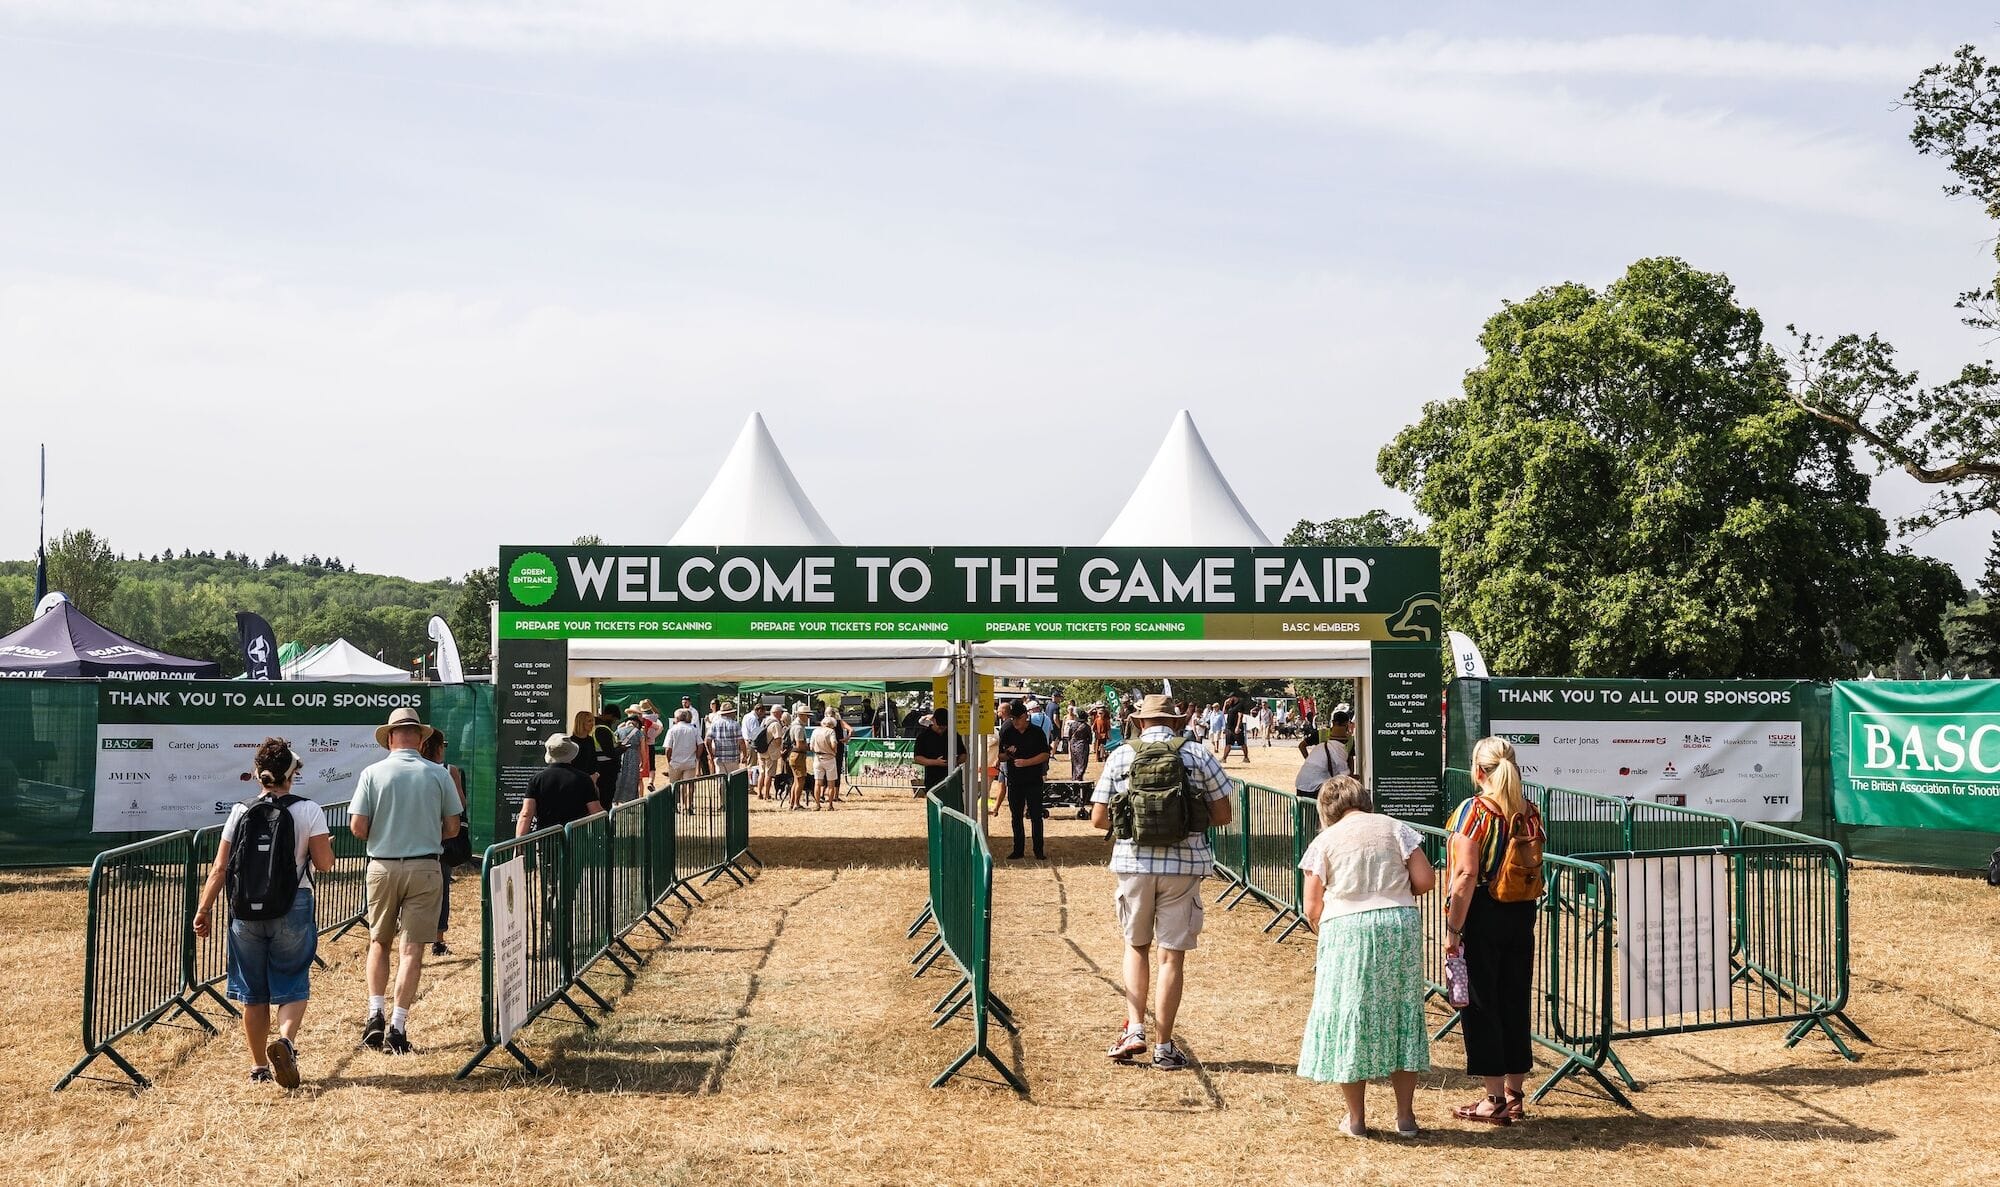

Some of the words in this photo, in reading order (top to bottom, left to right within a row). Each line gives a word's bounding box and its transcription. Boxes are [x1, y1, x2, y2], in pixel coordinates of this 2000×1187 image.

[567, 557, 835, 602] WELCOME
[856, 557, 931, 602] TO
[955, 557, 1058, 602] THE
[1079, 557, 1235, 602] GAME
[515, 621, 560, 631] PREPARE
[564, 621, 591, 631] YOUR
[595, 621, 636, 631] TICKETS
[639, 621, 659, 631] FOR
[662, 621, 713, 631] SCANNING
[750, 622, 795, 632] PREPARE
[799, 622, 826, 632] YOUR
[831, 622, 871, 632] TICKETS
[874, 622, 895, 632] FOR
[898, 622, 949, 632] SCANNING
[985, 623, 1031, 632] PREPARE
[1035, 623, 1062, 632] YOUR
[1066, 623, 1107, 632] TICKETS
[1111, 623, 1131, 632] FOR
[1135, 623, 1185, 632] SCANNING
[1282, 623, 1310, 632] BASC
[1313, 623, 1360, 632] MEMBERS
[109, 691, 170, 706] THANK
[178, 692, 216, 706] YOU
[222, 693, 246, 706] TO
[253, 694, 285, 706] ALL
[292, 694, 326, 707] OUR
[333, 694, 421, 707] SPONSORS
[1499, 690, 1553, 703] THANK
[1560, 690, 1594, 703] YOU
[1601, 690, 1622, 703] TO
[1629, 690, 1659, 703] ALL
[1665, 690, 1698, 703] OUR
[1704, 690, 1791, 703] SPONSORS
[105, 740, 137, 748] BASC
[169, 741, 194, 750] Carter
[197, 741, 219, 750] Jonas
[1553, 736, 1576, 745] Carter
[1579, 736, 1599, 745] Jonas
[1863, 724, 2000, 774] BASC
[1851, 780, 1868, 790] The
[1871, 781, 1898, 791] British
[1900, 783, 1950, 794] Association
[1952, 784, 1965, 795] for
[1763, 796, 1789, 804] YETI
